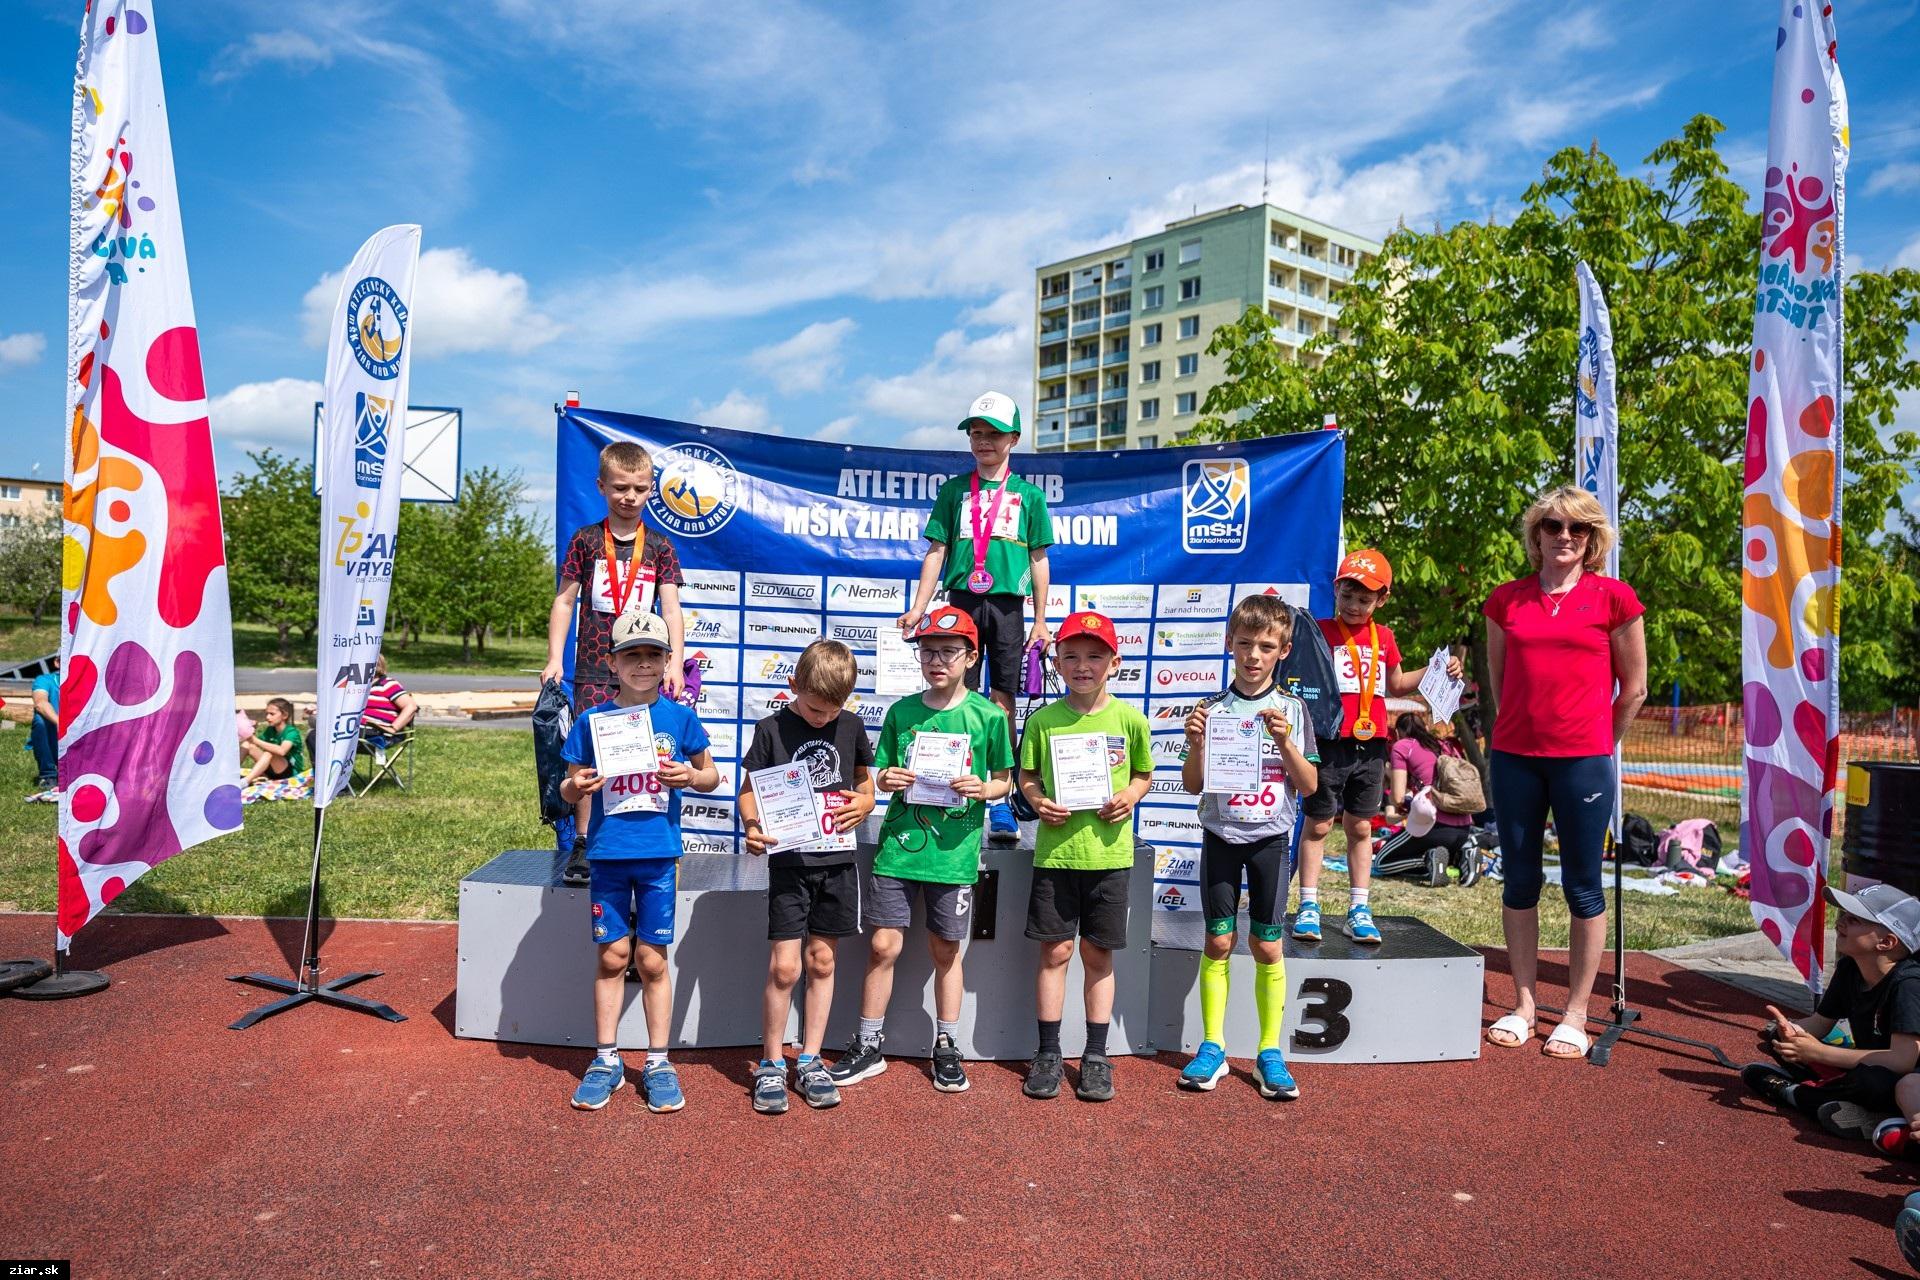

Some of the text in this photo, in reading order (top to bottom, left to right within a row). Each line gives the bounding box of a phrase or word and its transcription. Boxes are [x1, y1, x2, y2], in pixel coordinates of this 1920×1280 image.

[837, 468, 958, 501] ATLETIC
[783, 502, 849, 538] MŠK
[855, 505, 919, 541] ŽIAR
[1052, 515, 1118, 546] NOM
[677, 582, 736, 592] P4RUNNING
[751, 584, 815, 598] SLOVALCO
[848, 584, 899, 599] Nemak
[1164, 605, 1222, 614] žiar nad hronom
[693, 619, 721, 632] ŽIAR
[749, 624, 817, 635] TOP4RUNNING
[833, 627, 877, 639] SLOVAL
[1116, 635, 1143, 644] OLIA
[773, 661, 796, 675] ŽIA
[1106, 669, 1142, 681] PES
[1174, 672, 1217, 681] VEOLIA
[766, 700, 791, 709] ICE
[856, 704, 884, 717] ŽIAR
[700, 707, 730, 715] hronom
[1169, 706, 1194, 718] AP
[861, 715, 880, 723] HYBE
[610, 772, 662, 796] 408
[681, 804, 729, 819] APES
[1143, 820, 1204, 830] TOP4RUNNIN
[682, 840, 729, 853] Nemak
[1167, 858, 1195, 870] ŽIAR
[1157, 895, 1187, 906] ICEL
[1295, 977, 1353, 1049] 3
